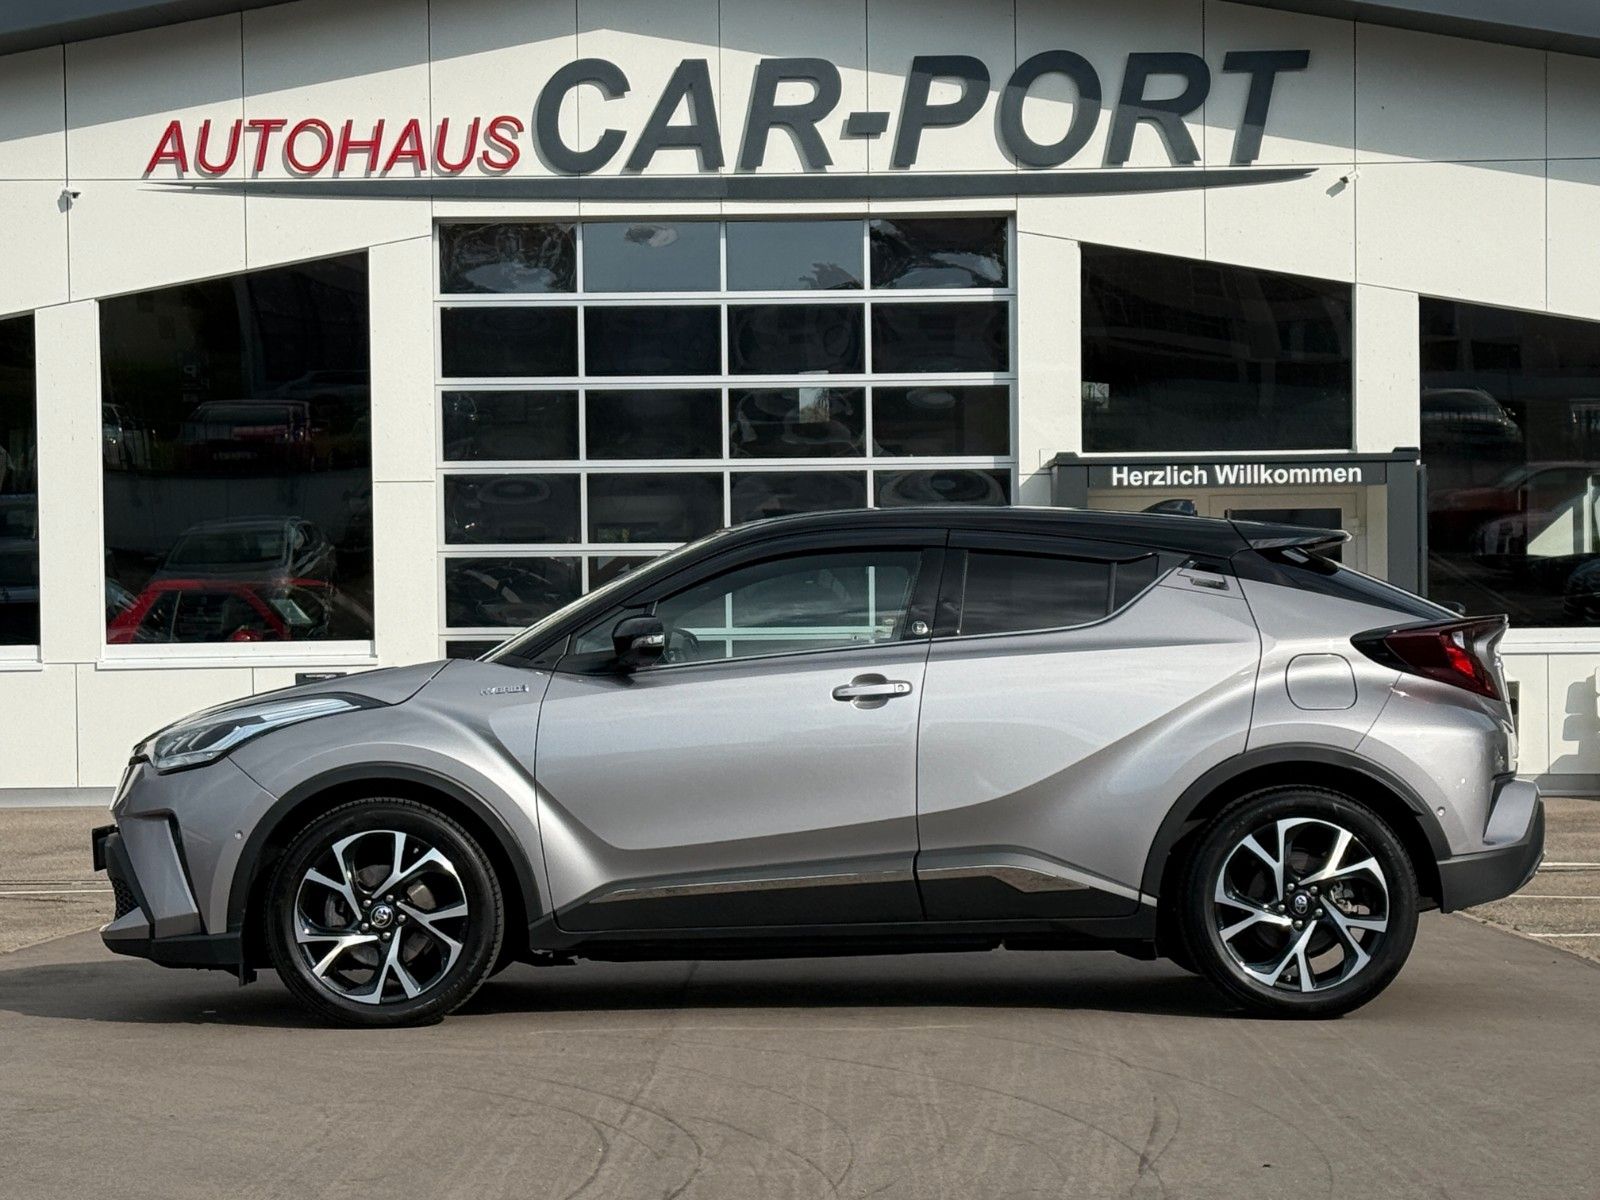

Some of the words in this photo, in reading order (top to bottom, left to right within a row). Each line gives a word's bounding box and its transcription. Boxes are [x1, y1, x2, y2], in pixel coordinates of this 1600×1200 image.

[145, 116, 524, 175] AUTOHAUS
[536, 49, 1310, 174] CAR-PORT
[1111, 466, 1208, 486] Herzlich
[1214, 464, 1362, 485] Willkommen
